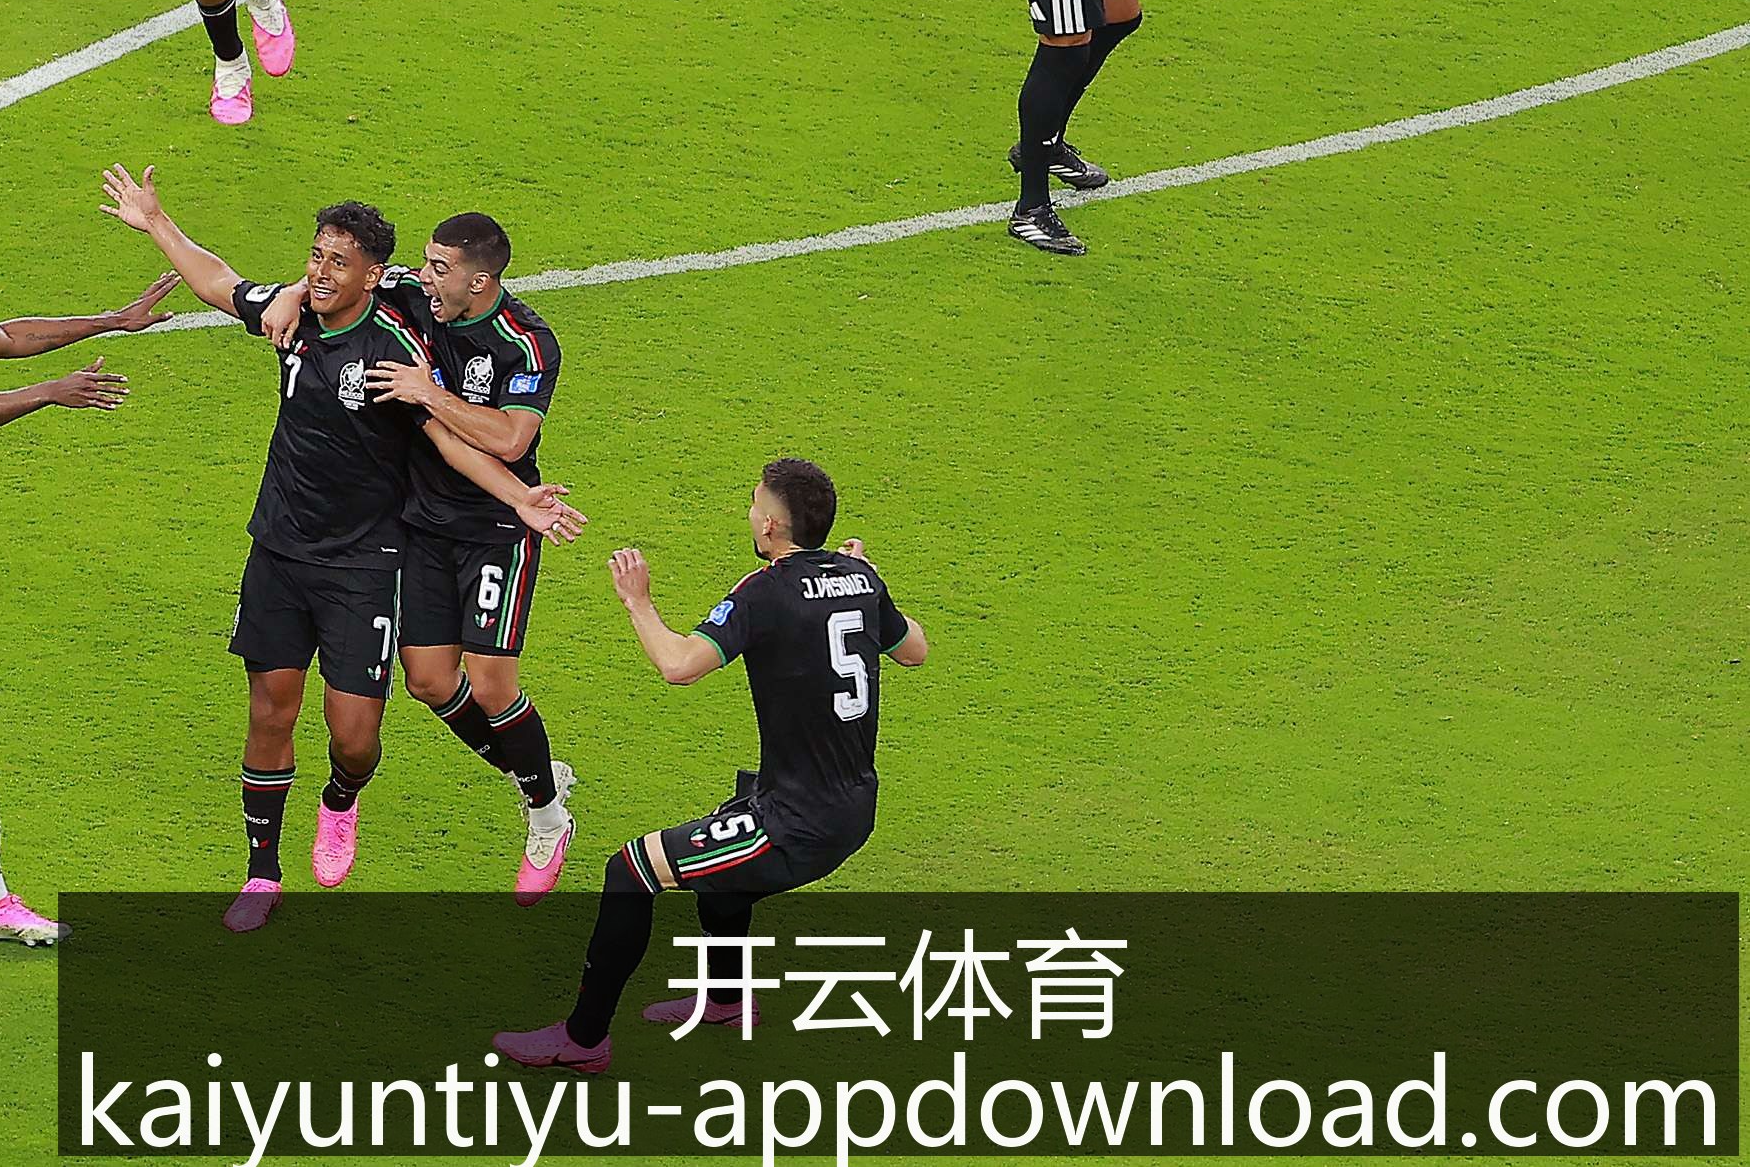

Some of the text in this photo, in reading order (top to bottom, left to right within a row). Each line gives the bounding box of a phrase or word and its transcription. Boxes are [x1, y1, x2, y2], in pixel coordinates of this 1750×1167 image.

[284, 354, 302, 399] 7
[477, 564, 503, 610] 6
[373, 616, 391, 662] 7
[827, 610, 869, 721] 5
[709, 814, 754, 842] 5
